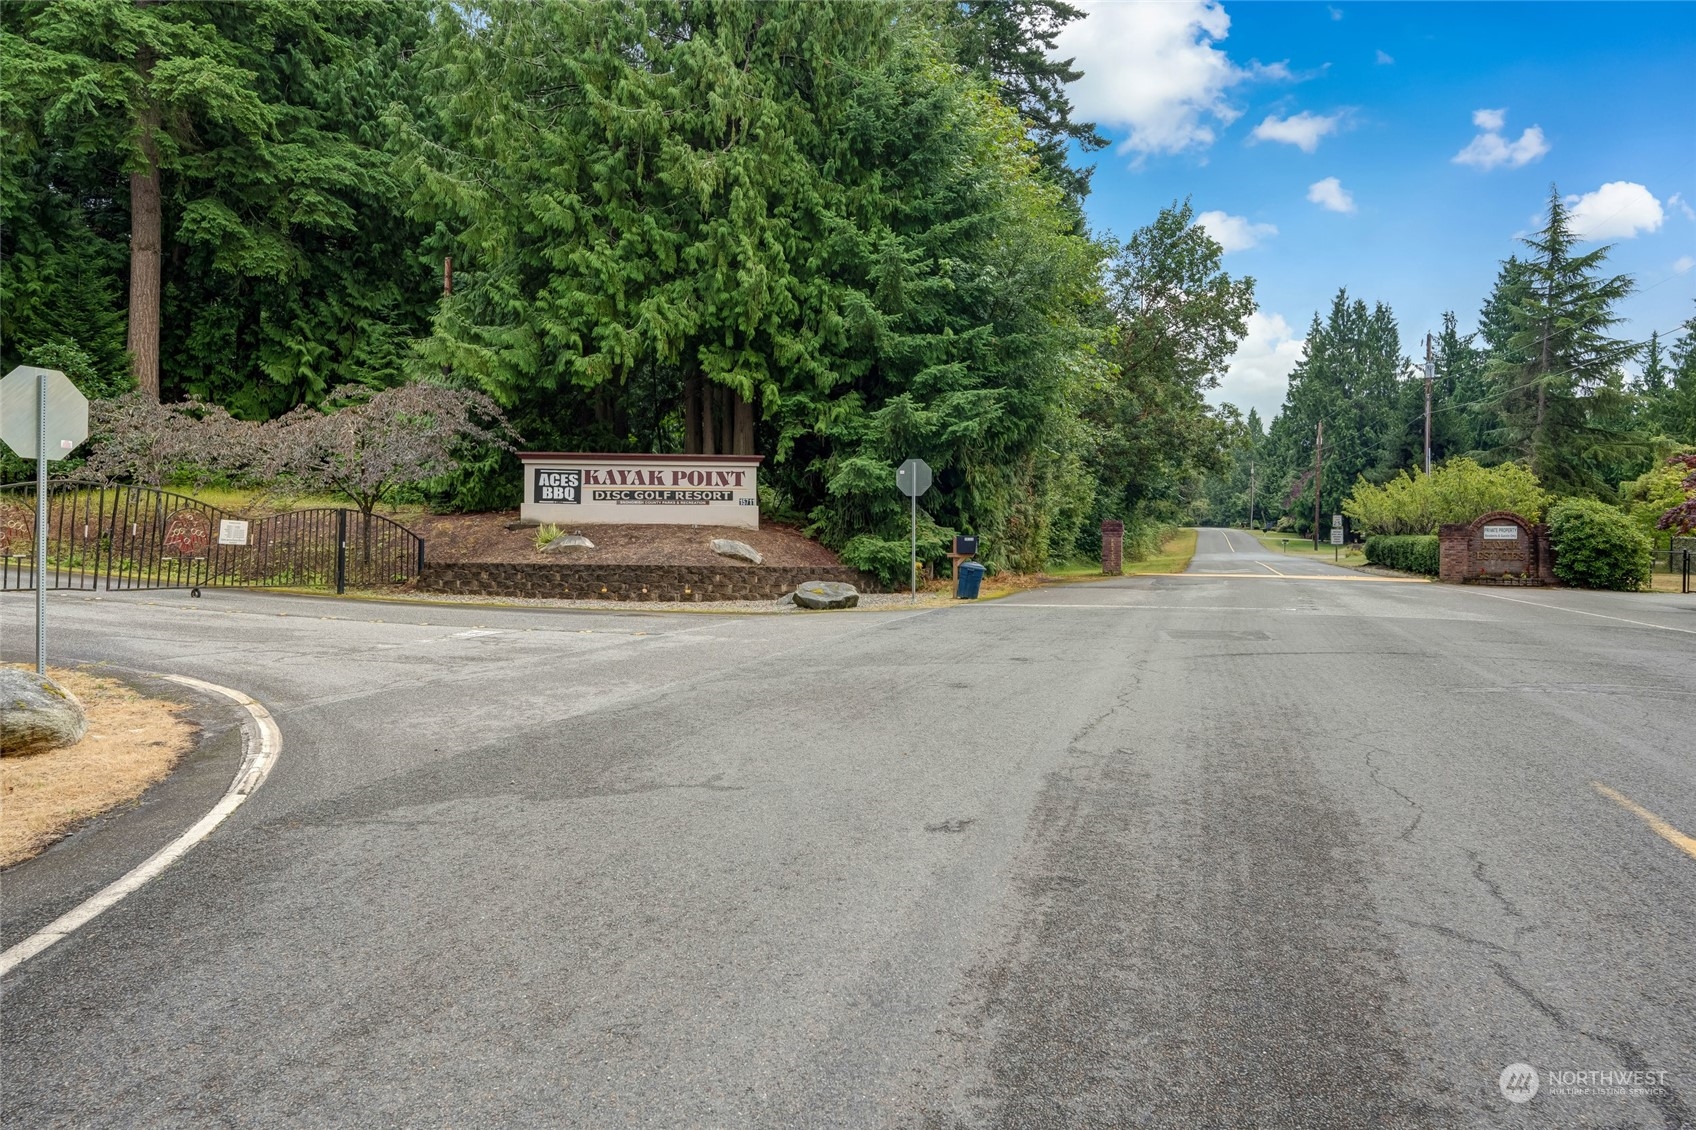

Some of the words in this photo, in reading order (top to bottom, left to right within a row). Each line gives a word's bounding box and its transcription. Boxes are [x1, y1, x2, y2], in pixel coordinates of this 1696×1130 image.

[538, 473, 579, 487] ACES
[583, 469, 666, 486] KAYAK
[671, 470, 746, 487] POINT
[542, 486, 575, 501] BBQ
[595, 491, 630, 500] DISC
[634, 491, 671, 500] GOLF
[675, 491, 731, 500] RESORT
[1481, 541, 1520, 550] KAYAK
[1476, 551, 1525, 561] ESTATES
